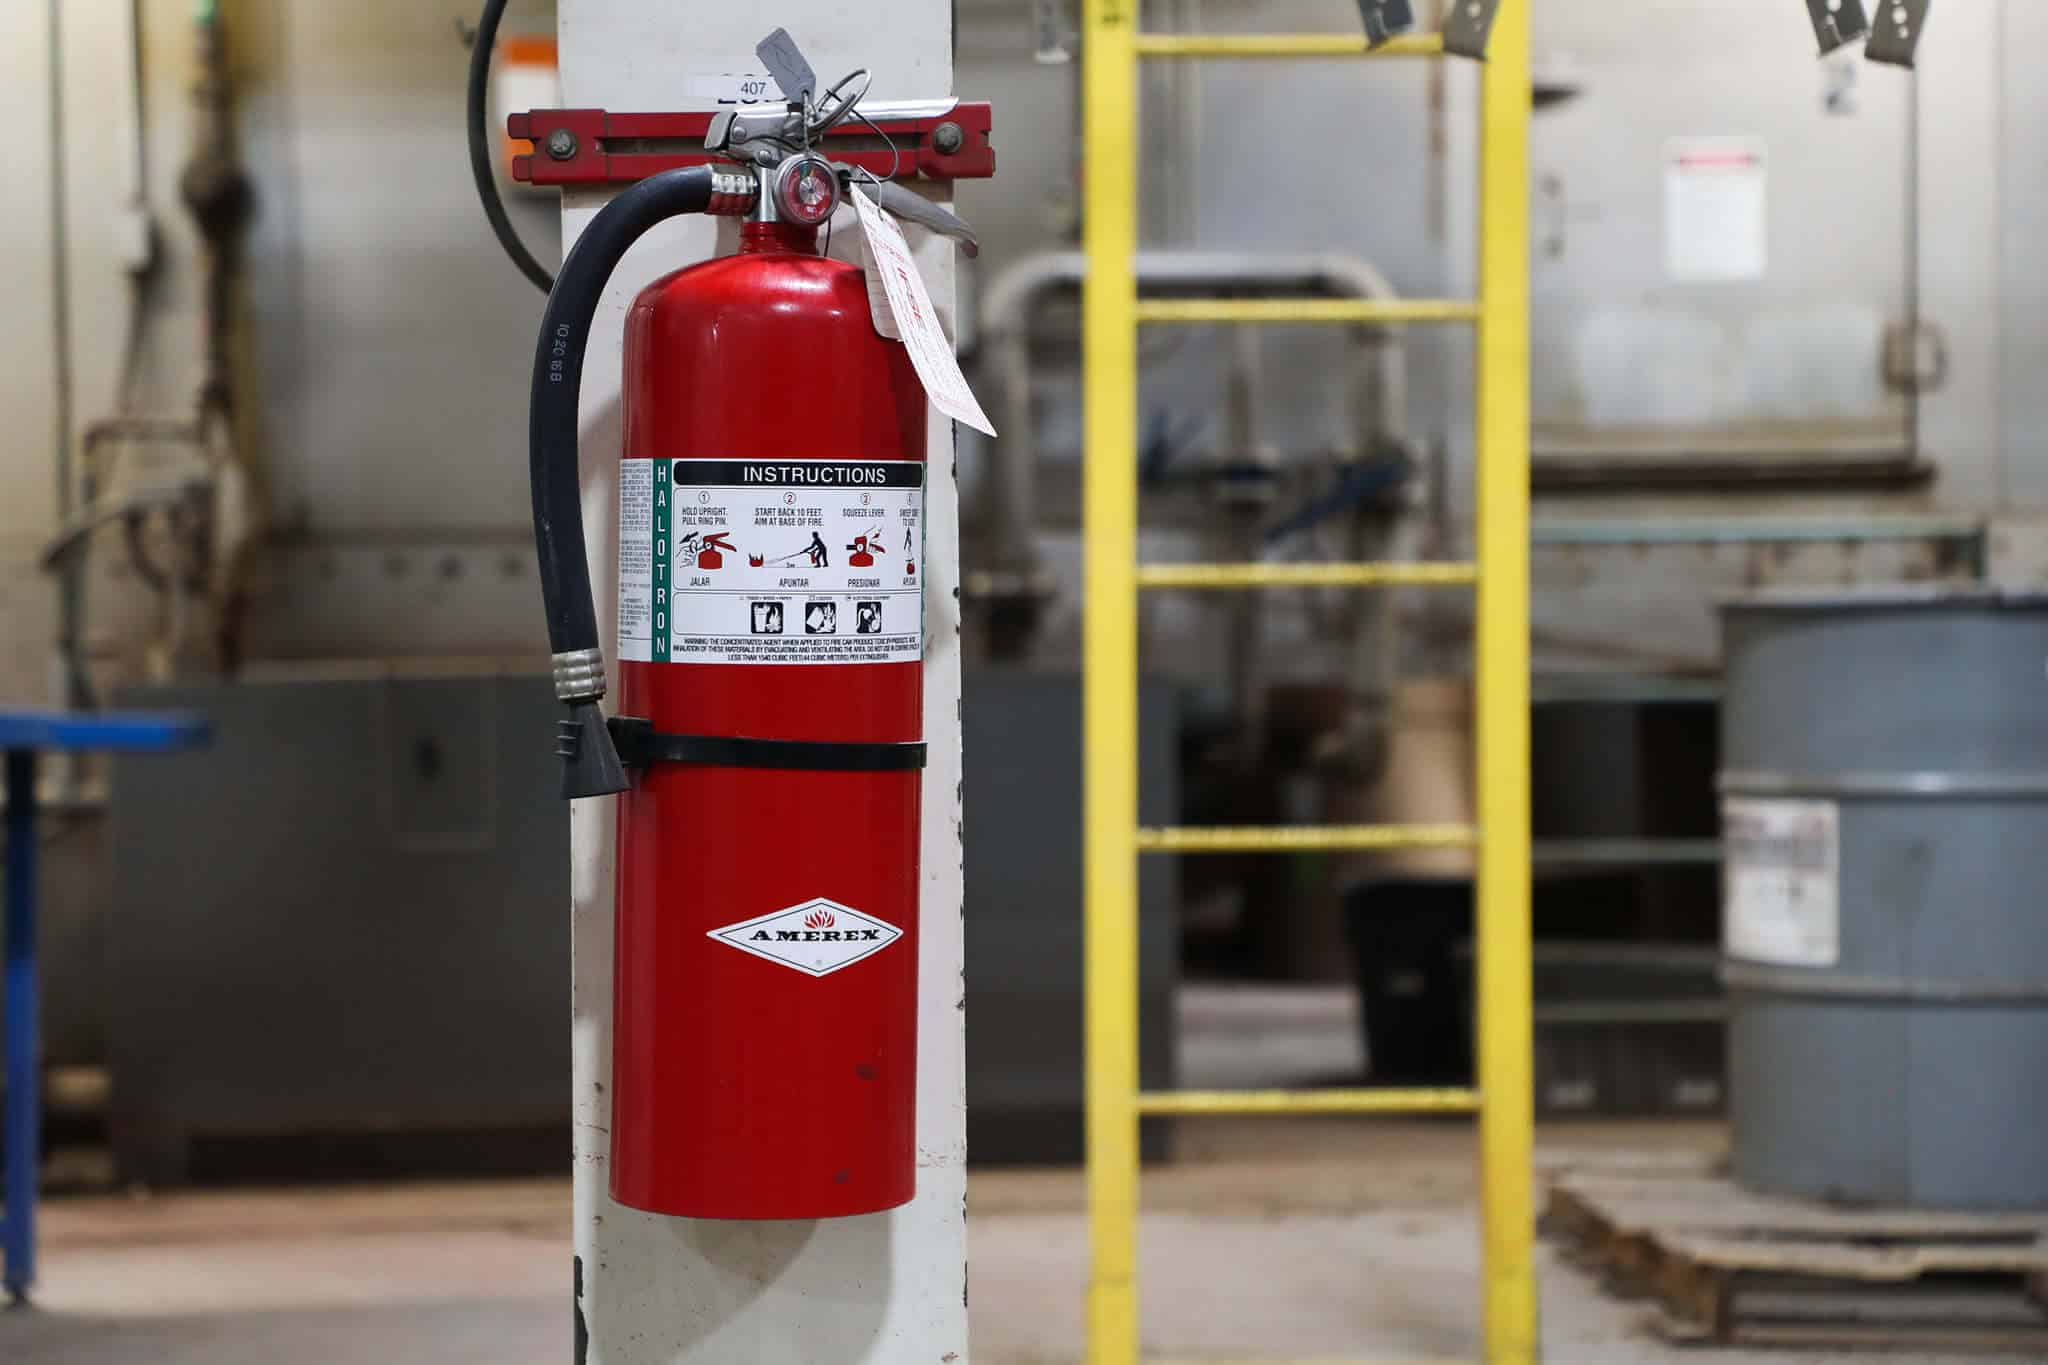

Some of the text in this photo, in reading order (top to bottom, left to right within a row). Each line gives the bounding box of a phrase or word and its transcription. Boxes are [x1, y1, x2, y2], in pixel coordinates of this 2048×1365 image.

[740, 81, 767, 95] 407
[743, 466, 887, 483] INSTRUCTIONS
[682, 507, 698, 516] HOLD
[755, 507, 776, 517] START
[777, 507, 795, 517] BACK
[796, 507, 805, 517] 10
[842, 508, 868, 517] SQUEEZE
[682, 517, 697, 526] PULL
[698, 517, 714, 526] RING
[754, 517, 768, 526] AIM
[768, 517, 777, 526] AT
[778, 517, 796, 526] BASE
[797, 517, 806, 526] OF
[656, 465, 667, 653] HALOTRON
[689, 577, 711, 586] JALAR
[779, 578, 809, 588] APUNTAR
[847, 578, 880, 588] PRESIONAR
[749, 929, 881, 942] AMEREX
